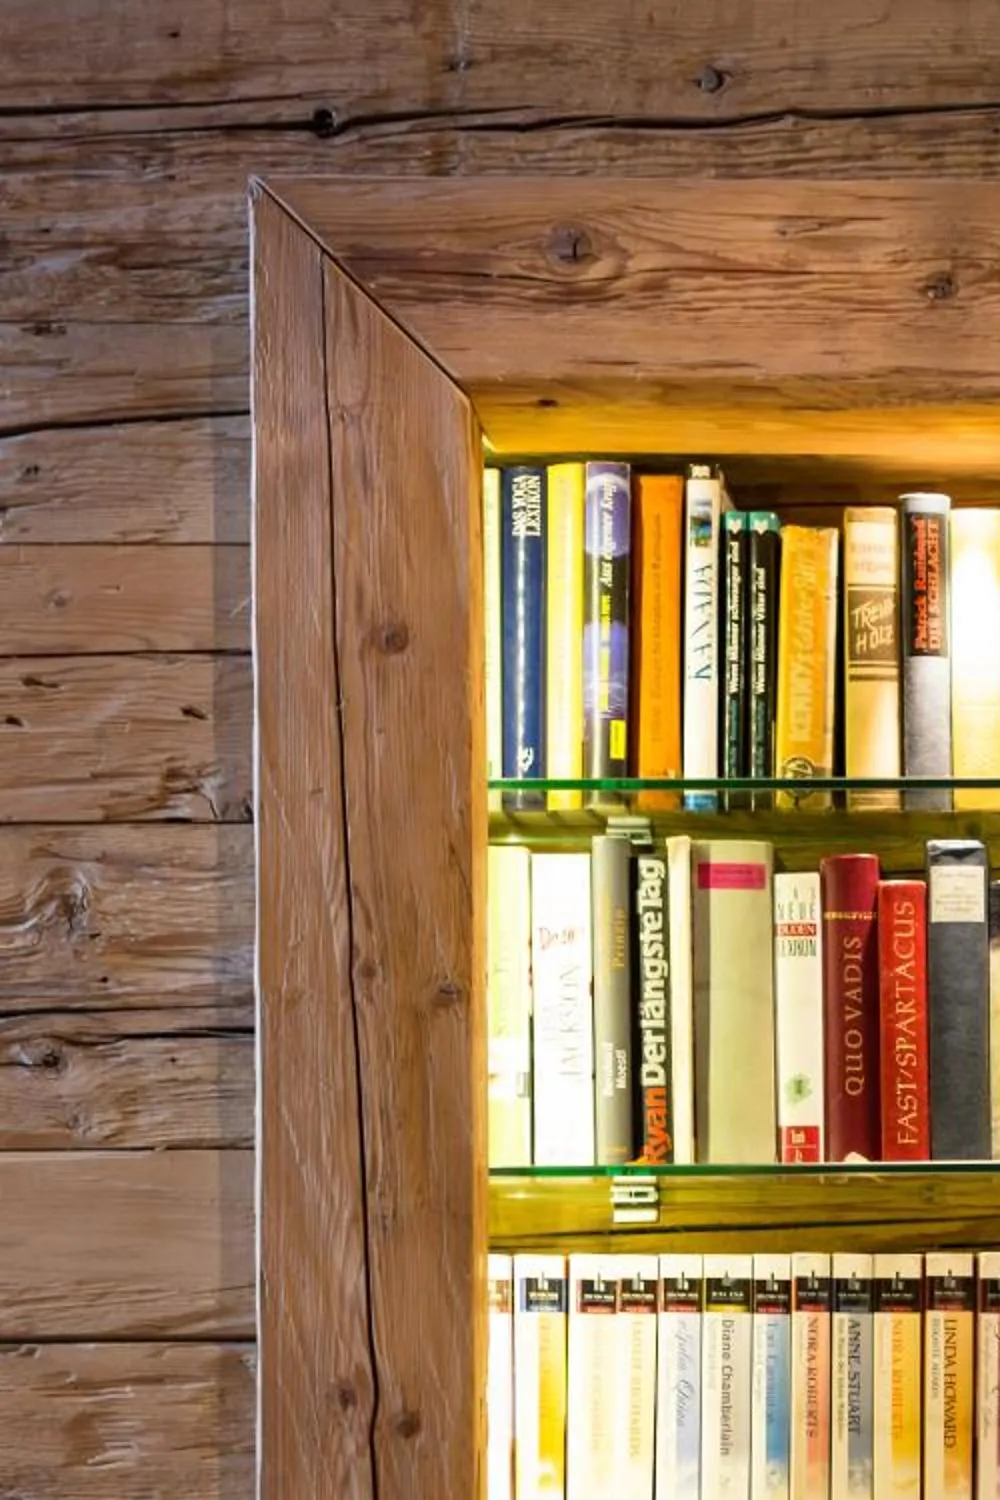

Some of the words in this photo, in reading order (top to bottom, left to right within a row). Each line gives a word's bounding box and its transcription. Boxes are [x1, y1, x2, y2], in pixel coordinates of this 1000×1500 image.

[512, 475, 527, 509] YOGA
[526, 475, 541, 536] LEXIKON
[689, 564, 713, 681] KANADA
[729, 663, 739, 692] Wenn
[756, 663, 766, 694] Wenn
[843, 936, 863, 1021] VADIS
[844, 1029, 865, 1096] QUO
[639, 1088, 672, 1164] Ryan
[721, 1319, 735, 1360] Diane
[807, 1316, 818, 1361] NORA
[848, 1319, 861, 1366] ANNE
[944, 1319, 957, 1367] LINDA
[720, 1365, 734, 1456] Chamberlain
[807, 1367, 818, 1438] ROBERTS
[848, 1371, 861, 1436] STUART
[943, 1373, 957, 1449] HOWARD
